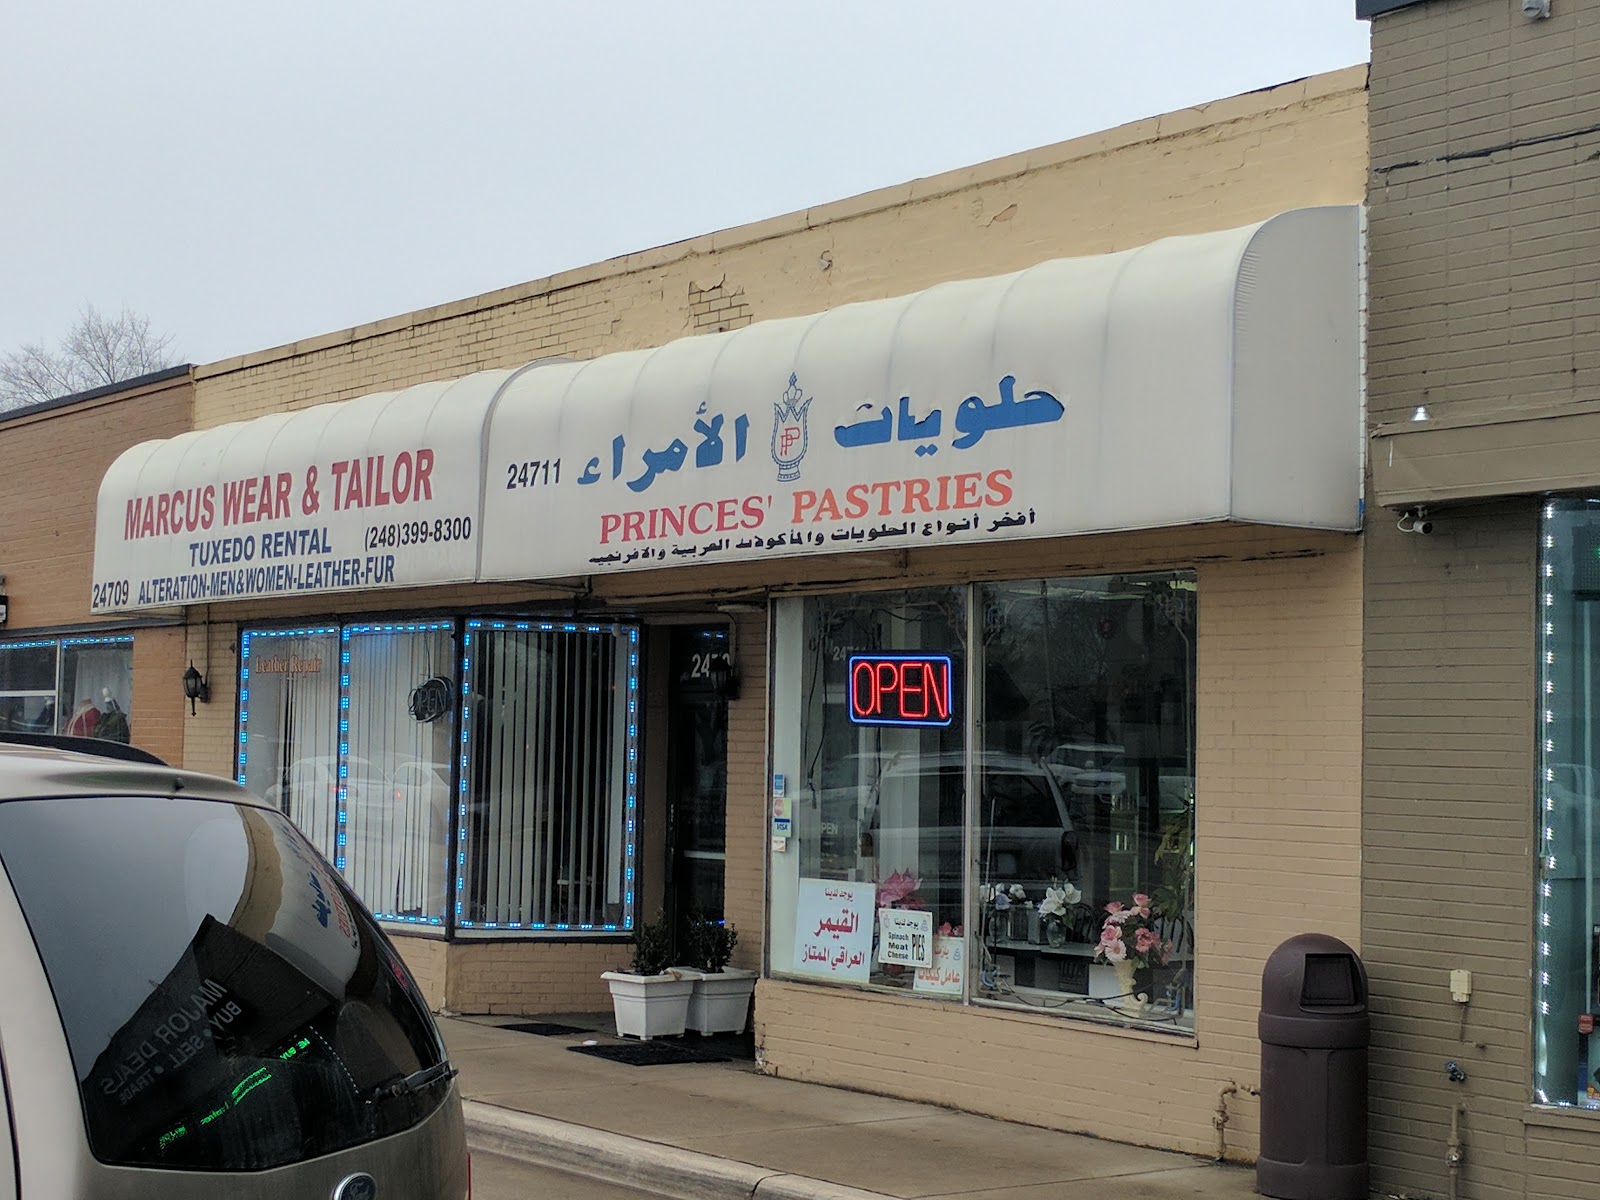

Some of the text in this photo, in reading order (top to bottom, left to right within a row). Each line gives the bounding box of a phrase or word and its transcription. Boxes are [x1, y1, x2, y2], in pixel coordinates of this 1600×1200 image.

[577, 375, 1066, 493] حلويات الأمراء
[506, 458, 562, 489] 24711
[124, 449, 434, 540] MARCUS WEAR & TAILOR
[599, 469, 1013, 544] PRINCES' PASTRIES
[364, 516, 472, 552] (248)399-8300
[831, 521, 916, 542] الحلويات
[921, 513, 980, 536] أنواع
[986, 507, 1036, 532] أفخر
[189, 527, 332, 567] TUXEDO RENTAL
[671, 537, 731, 557] العربية
[92, 580, 129, 609] 24709
[255, 653, 322, 677] Leather Repair
[853, 661, 948, 719] OPEN
[813, 908, 859, 940] القيمر
[831, 946, 865, 971] العراقي
